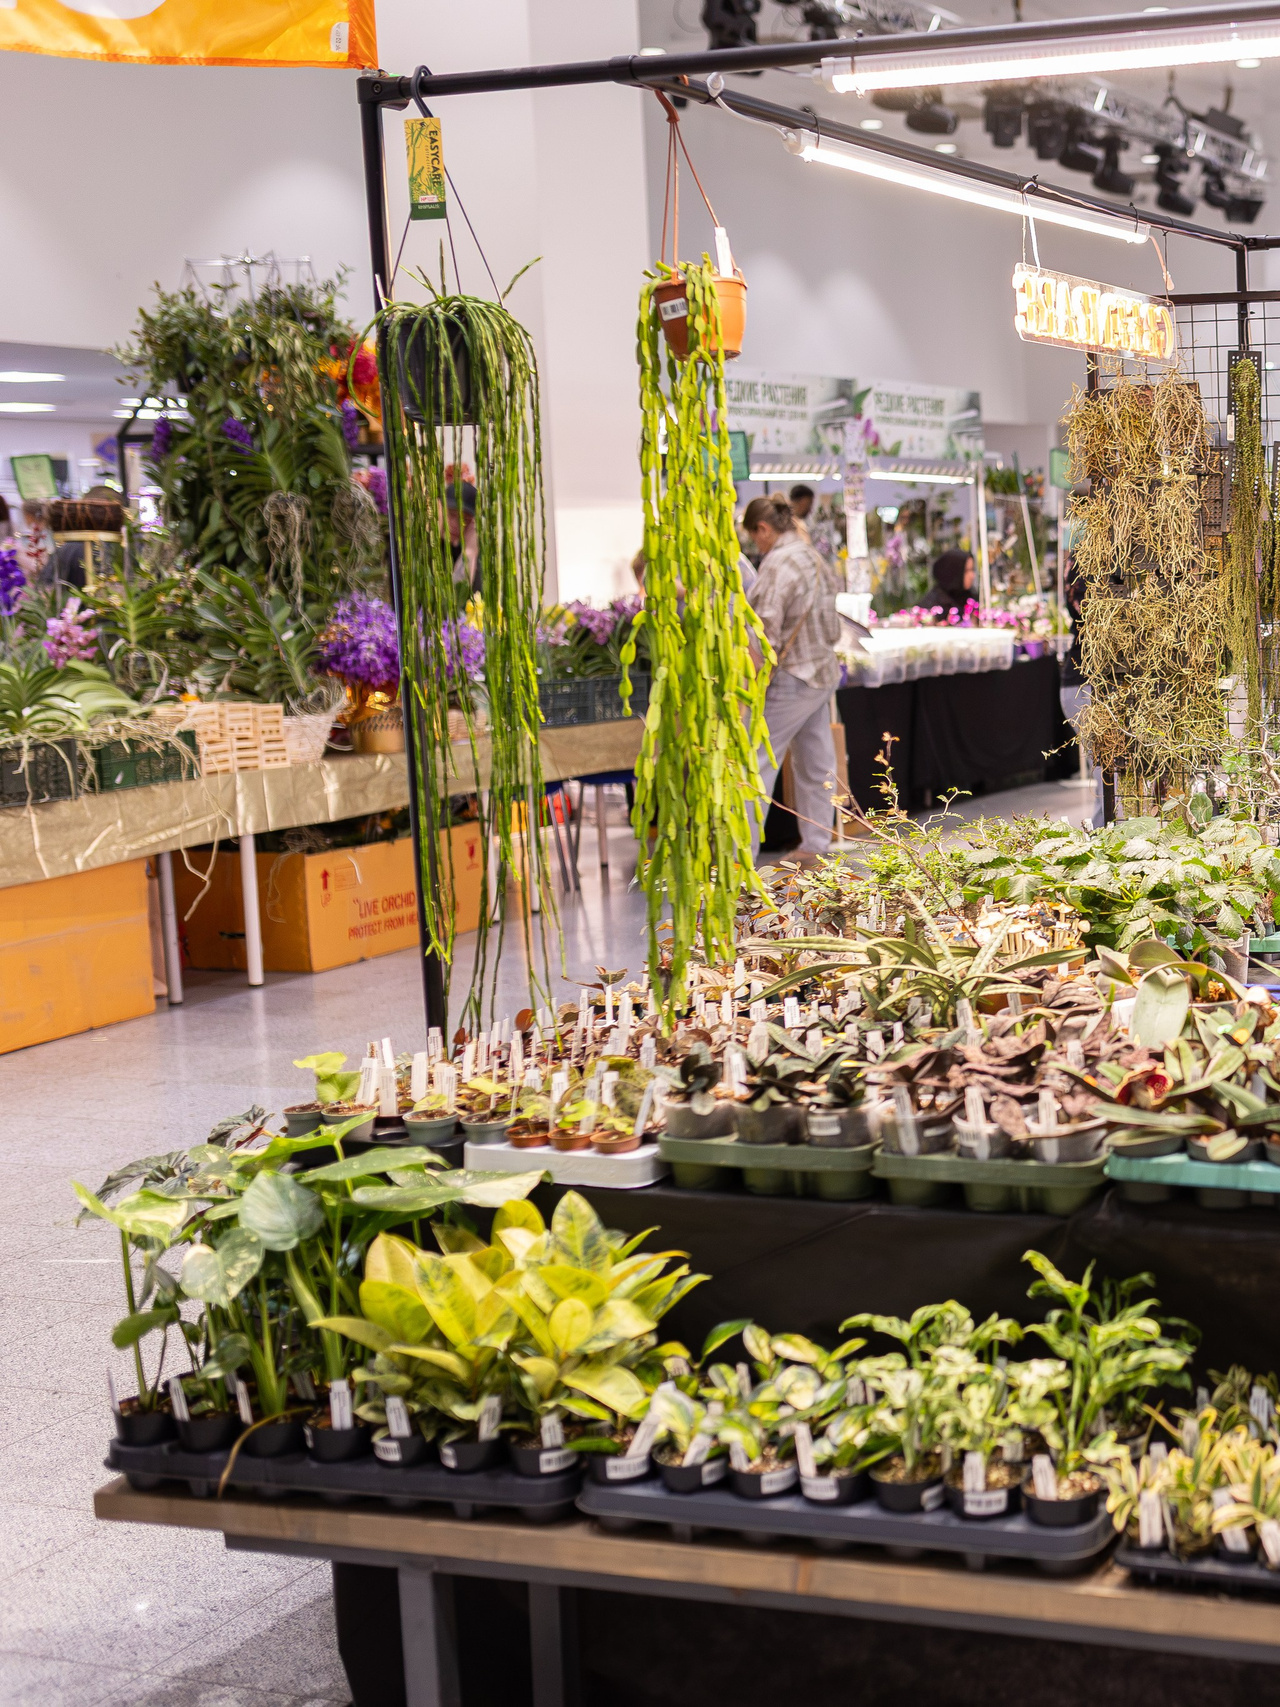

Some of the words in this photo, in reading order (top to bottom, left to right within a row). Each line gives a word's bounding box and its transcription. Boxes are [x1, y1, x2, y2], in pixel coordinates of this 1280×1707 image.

[428, 130, 442, 188] EASYCARE
[348, 919, 382, 940] PROTECT
[383, 915, 405, 932] FROM
